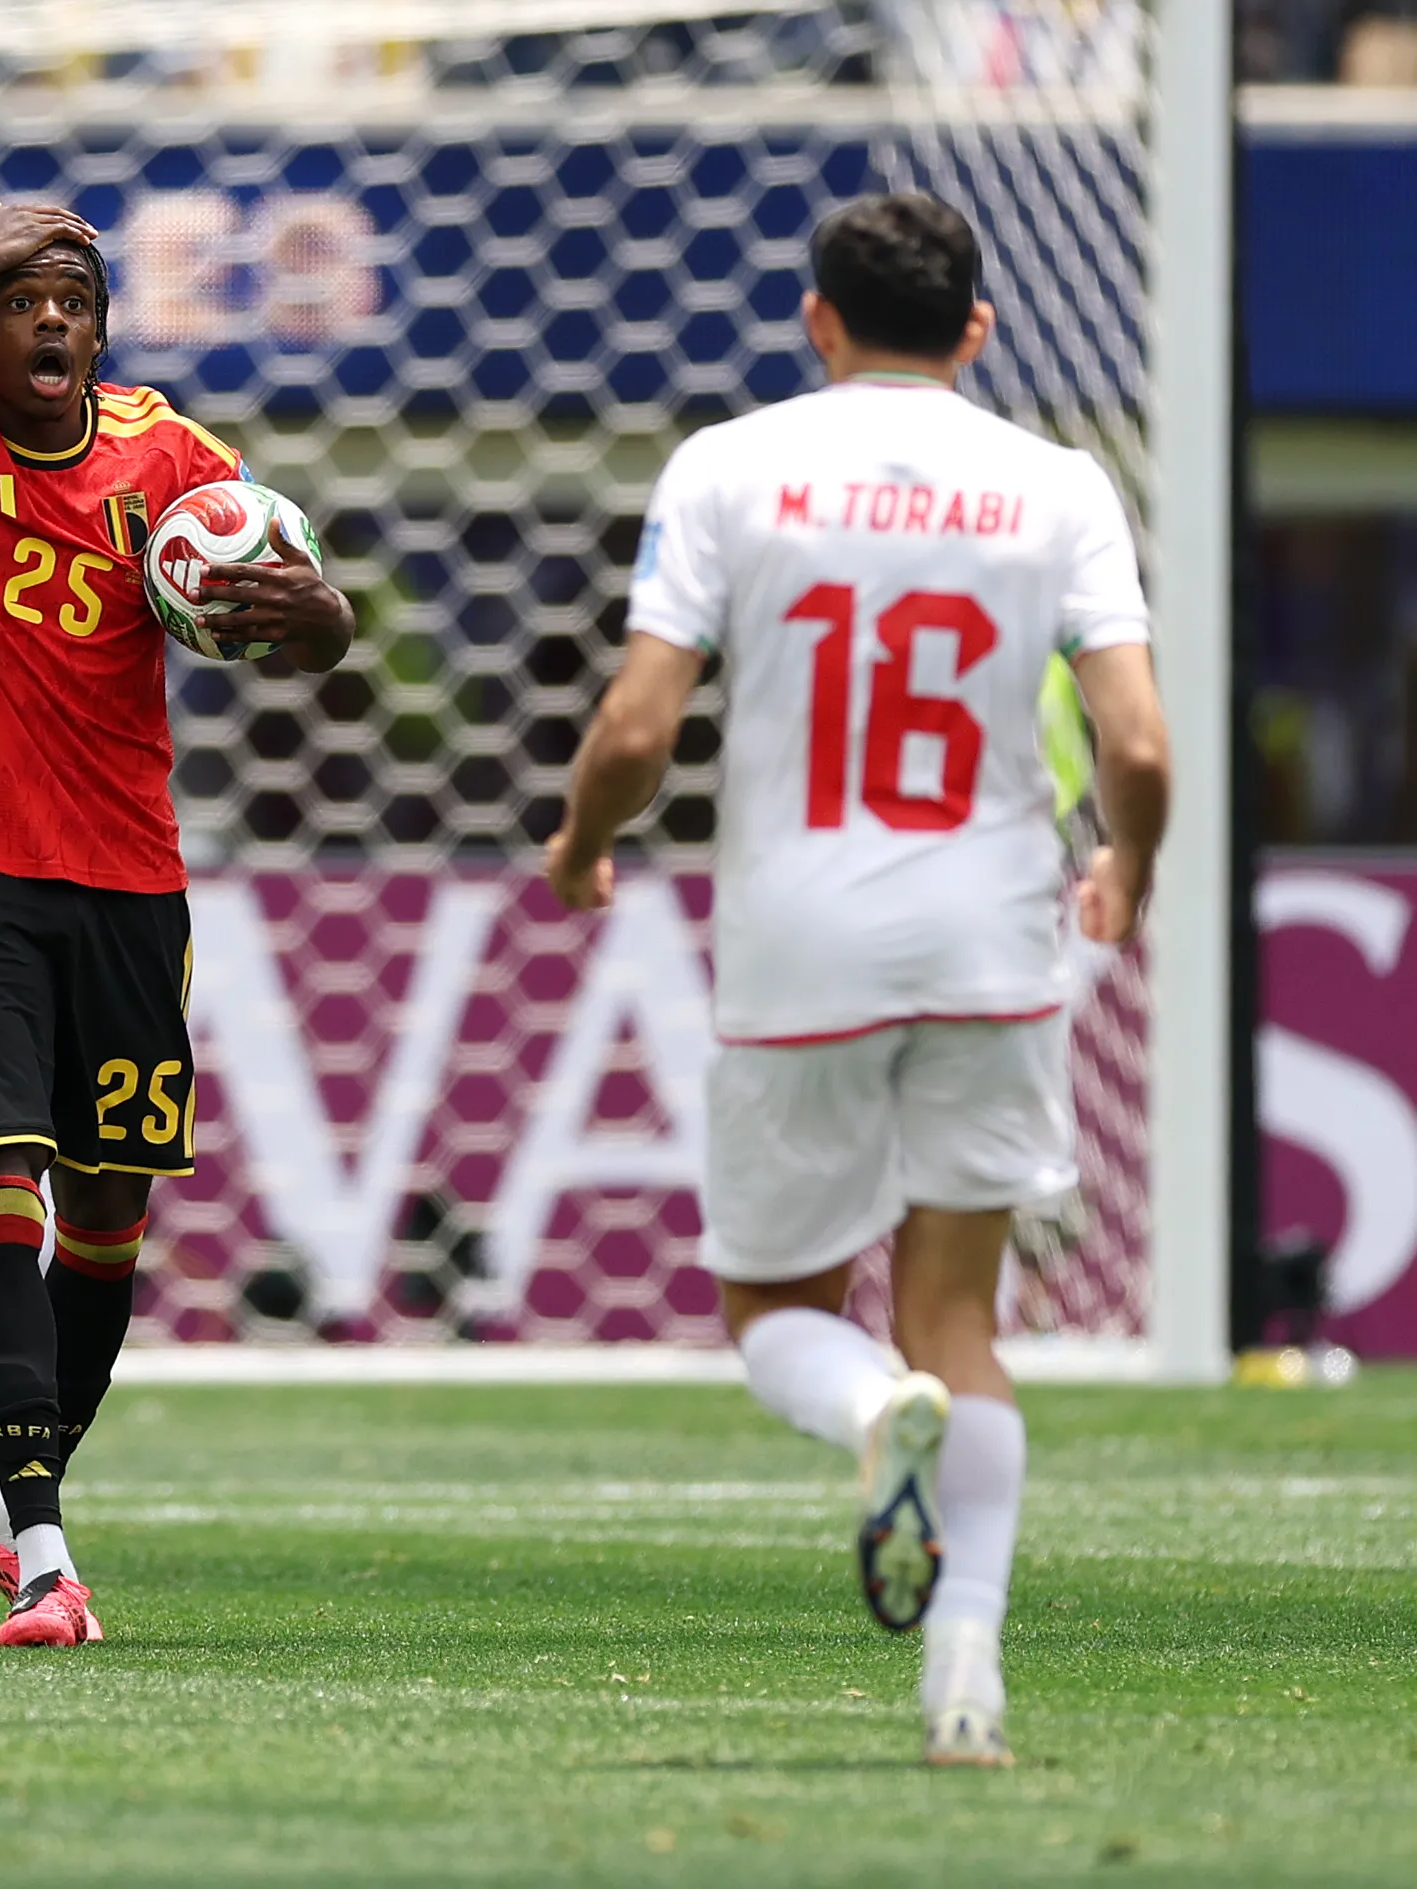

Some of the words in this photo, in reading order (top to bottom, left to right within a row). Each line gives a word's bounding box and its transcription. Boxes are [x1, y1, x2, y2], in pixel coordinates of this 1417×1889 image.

[842, 481, 1024, 538] TORABI
[3, 537, 113, 637] 25
[779, 579, 1002, 836] 16
[97, 1058, 182, 1145] 25
